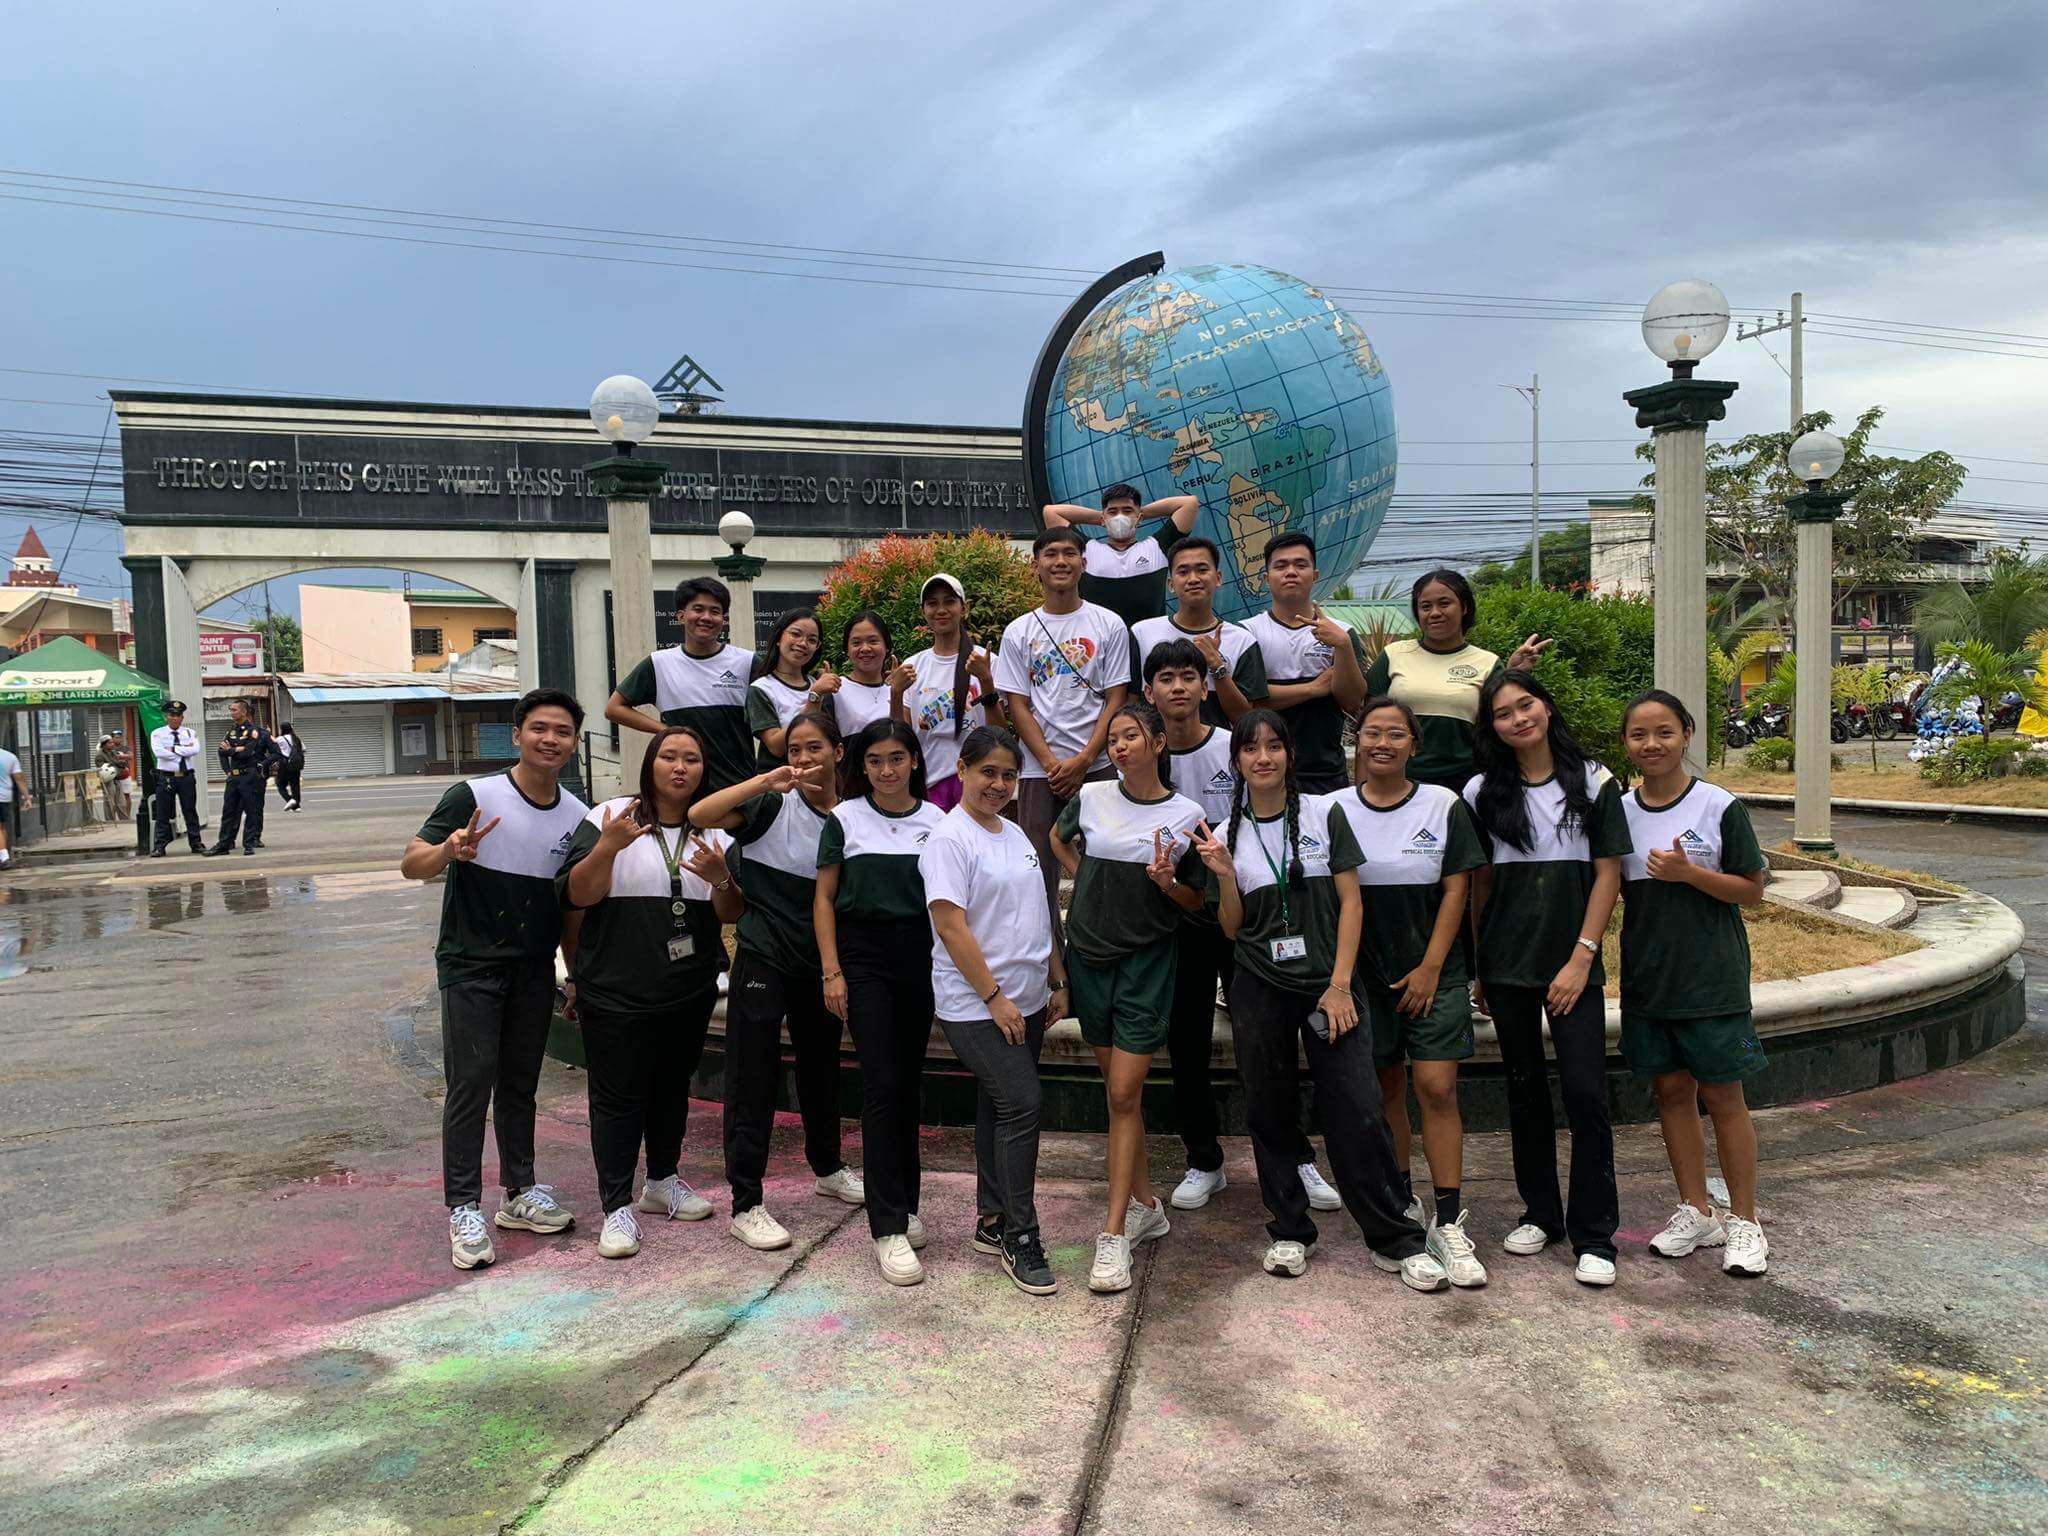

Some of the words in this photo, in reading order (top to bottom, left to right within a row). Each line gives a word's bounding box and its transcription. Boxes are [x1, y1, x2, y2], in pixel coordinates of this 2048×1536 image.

[1198, 307, 1284, 342] NORTH
[1170, 329, 1274, 371] ATLANTIC
[1250, 448, 1314, 479] BRAZIL
[153, 457, 288, 491] THROUGH
[298, 461, 354, 492] THIS
[362, 463, 430, 494] GATE
[438, 465, 500, 496] WILL
[507, 468, 563, 496] PASS
[721, 474, 817, 505] LEADERS
[825, 477, 853, 504] OF
[862, 478, 904, 505] OUR
[910, 480, 1009, 512] COUNTRY,
[1182, 474, 1212, 490] PERU
[1233, 489, 1266, 506] BOLIVIA
[199, 644, 230, 652] ENTER
[32, 676, 95, 686] Smart
[65, 690, 96, 699] LATEST
